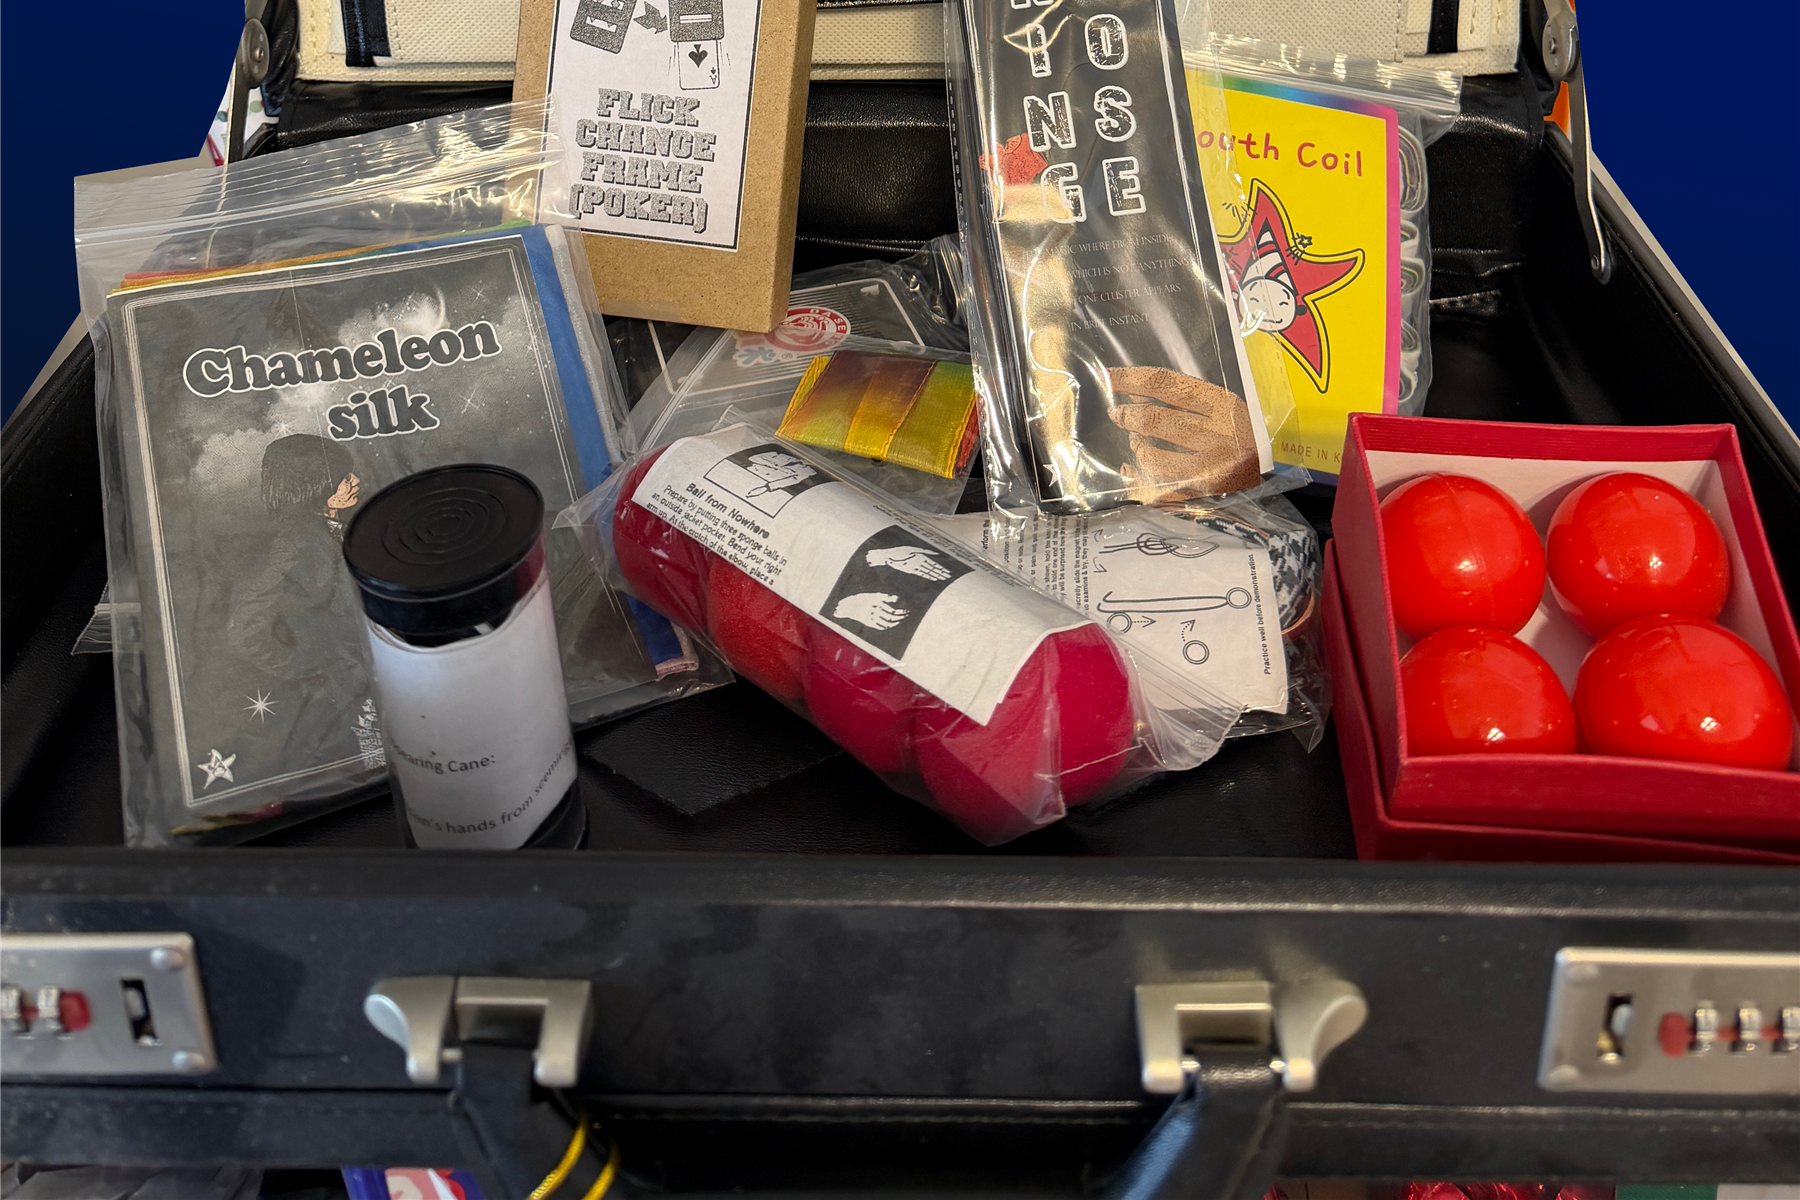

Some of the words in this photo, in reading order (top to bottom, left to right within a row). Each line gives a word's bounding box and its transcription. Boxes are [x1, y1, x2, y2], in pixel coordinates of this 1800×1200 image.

[596, 87, 700, 127] FLICK
[575, 118, 717, 162] CHANGE
[1196, 131, 1280, 161] outh
[1297, 142, 1363, 177] Coil
[580, 151, 704, 194] FRAME
[568, 183, 708, 234] (POKER)
[1078, 240, 1111, 253] WHERE
[1101, 265, 1111, 276] IS
[1100, 288, 1140, 301] CLUSTER
[1142, 283, 1182, 296] APPEARS
[183, 320, 503, 398] Chameleon
[327, 385, 440, 441] silk
[1281, 441, 1312, 458] MADE
[1317, 448, 1328, 461] IN
[664, 484, 689, 505] Prepare
[688, 498, 698, 511] by
[695, 506, 721, 527] putting
[720, 518, 738, 536] three
[737, 531, 763, 552] sponge
[762, 543, 779, 562] balls
[779, 554, 788, 567] in
[686, 483, 707, 500] Ball
[706, 494, 728, 513] from
[728, 508, 770, 540] Nowhere
[651, 492, 661, 502] an
[660, 496, 683, 515] outside
[727, 538, 748, 555] Bend
[745, 551, 765, 566] your
[763, 560, 782, 577] right
[1248, 553, 1261, 602] demonstration.
[1255, 603, 1265, 625] before
[1257, 626, 1266, 642] well
[1260, 643, 1271, 675] Practice
[447, 754, 496, 773] Cane:
[446, 818, 497, 835] hands
[501, 796, 533, 825] from
